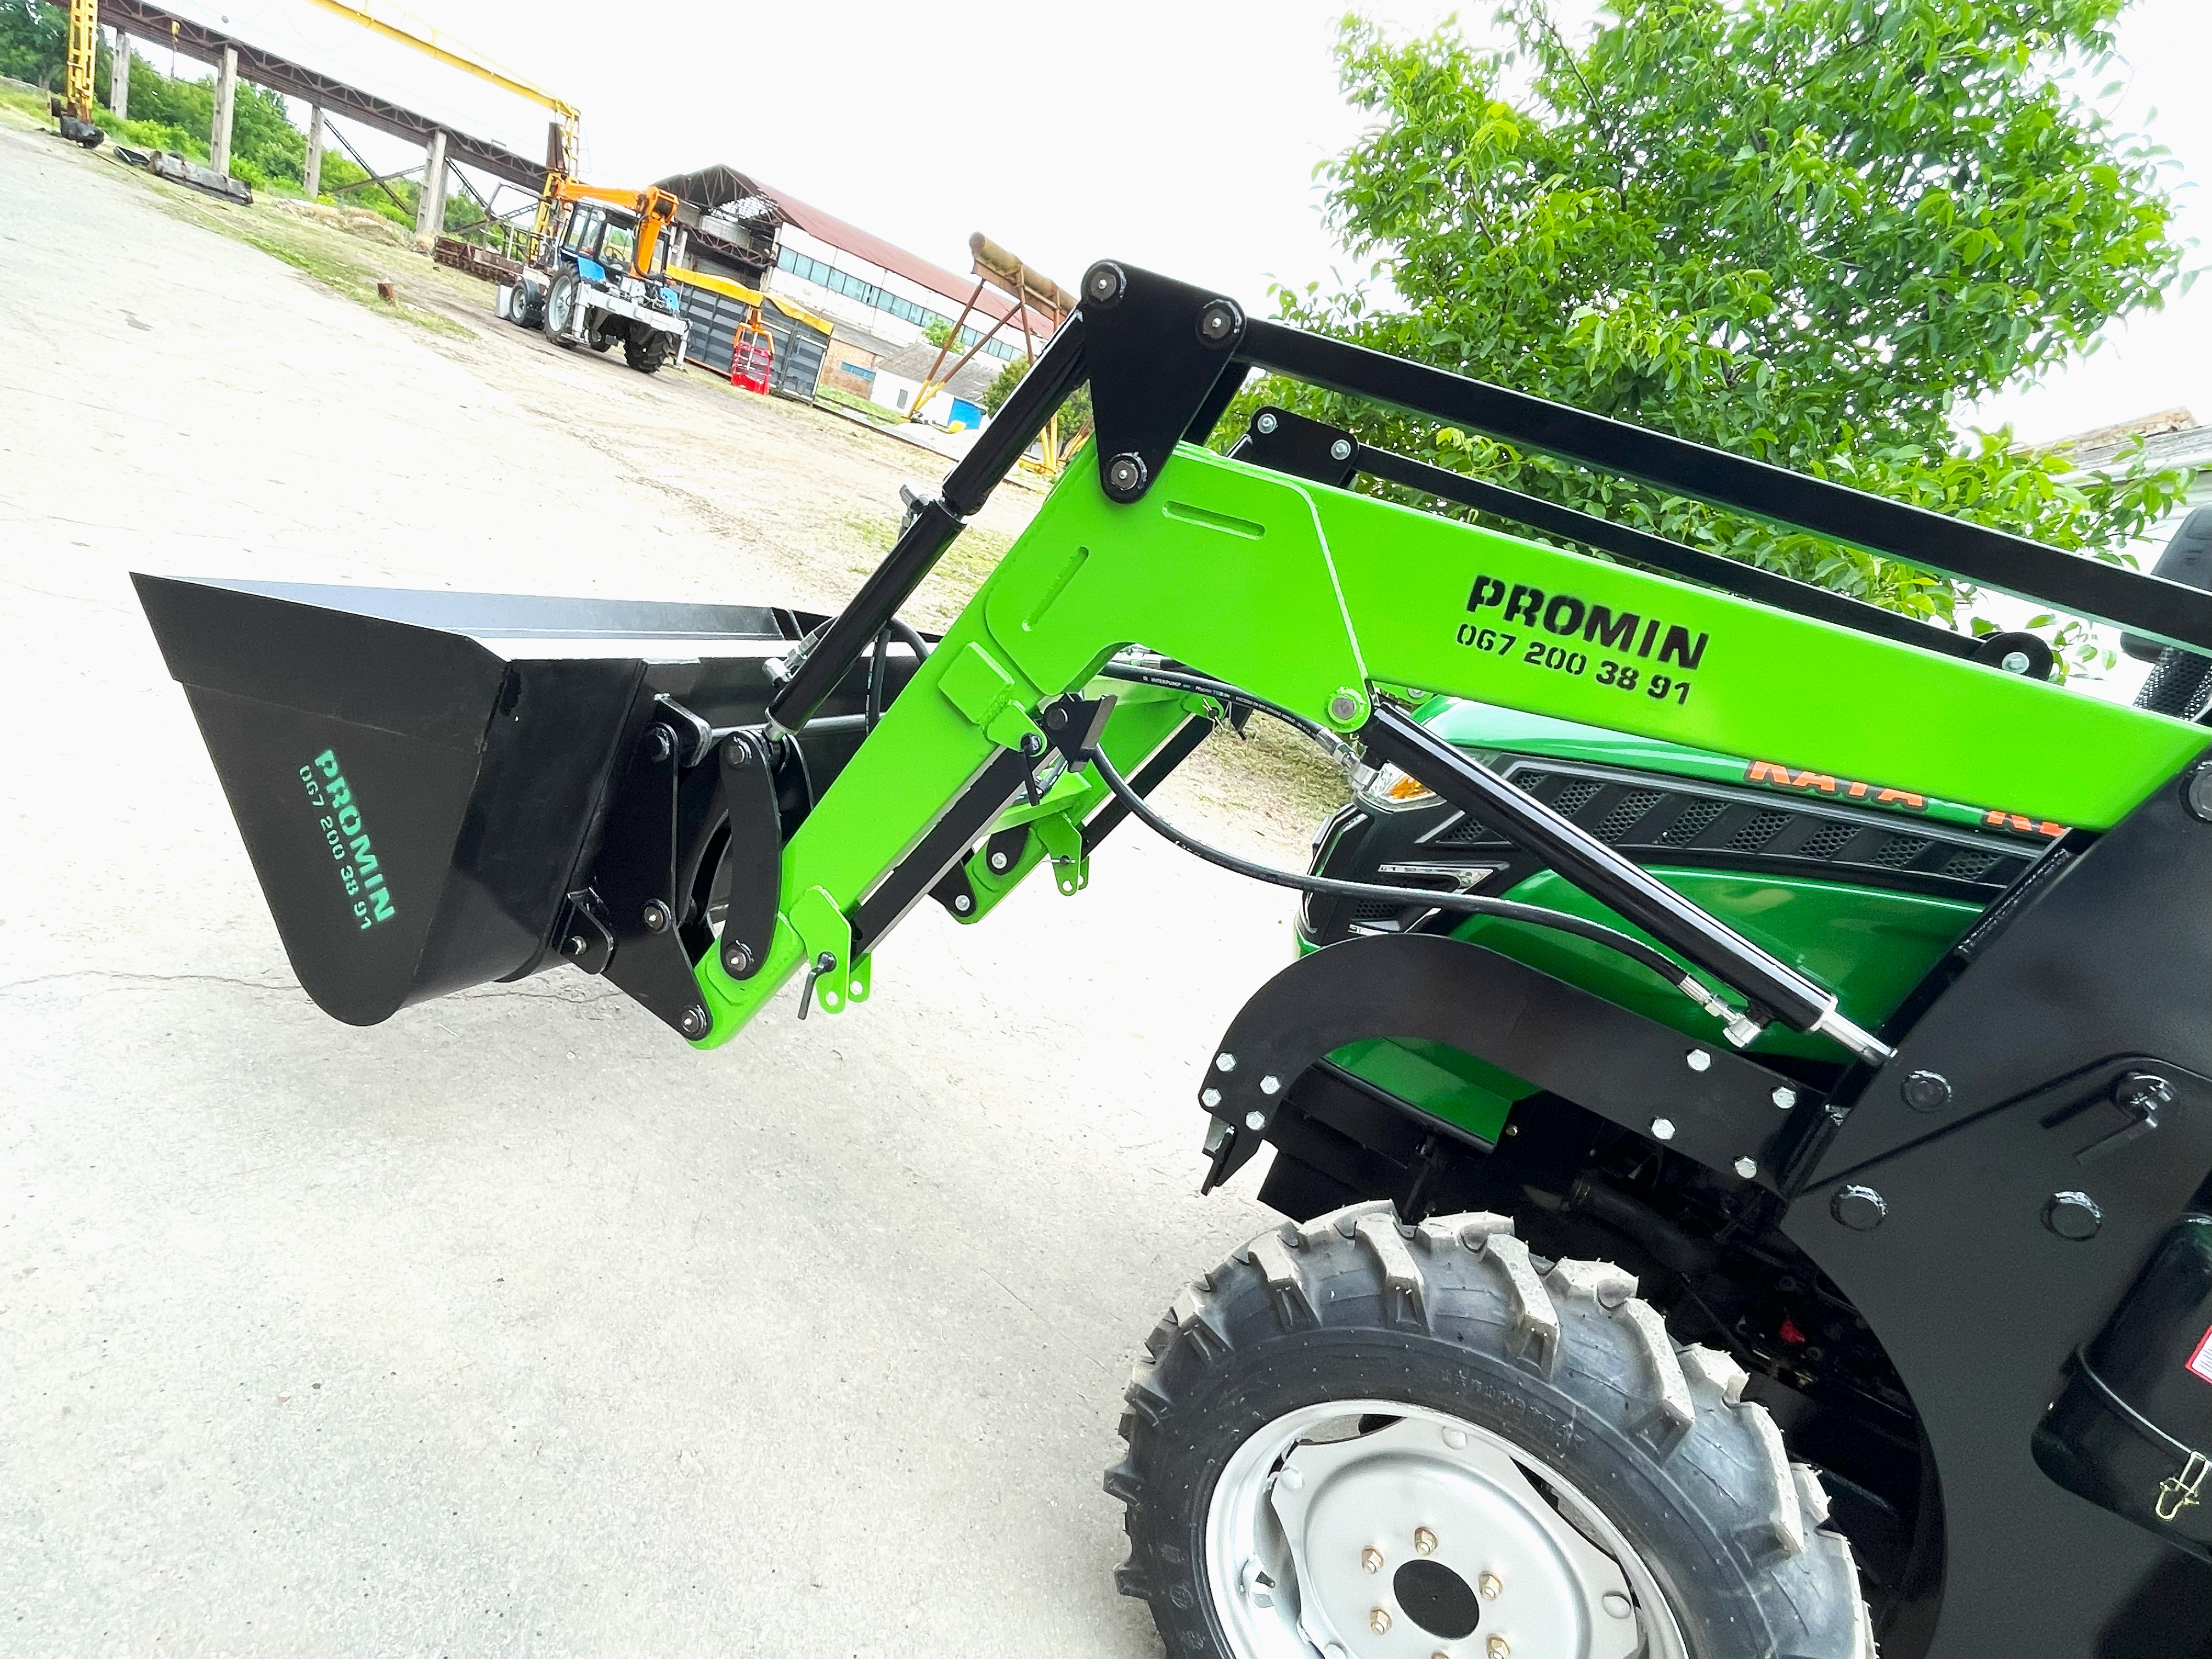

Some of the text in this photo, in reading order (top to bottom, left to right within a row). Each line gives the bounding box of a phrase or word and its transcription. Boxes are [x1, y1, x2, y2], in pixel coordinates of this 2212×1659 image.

[1457, 623, 1691, 705] 067 200 38 91
[1466, 574, 1709, 670] PROMIN
[300, 765, 373, 929] 067 200 38 91
[314, 749, 396, 922] PROMIN
